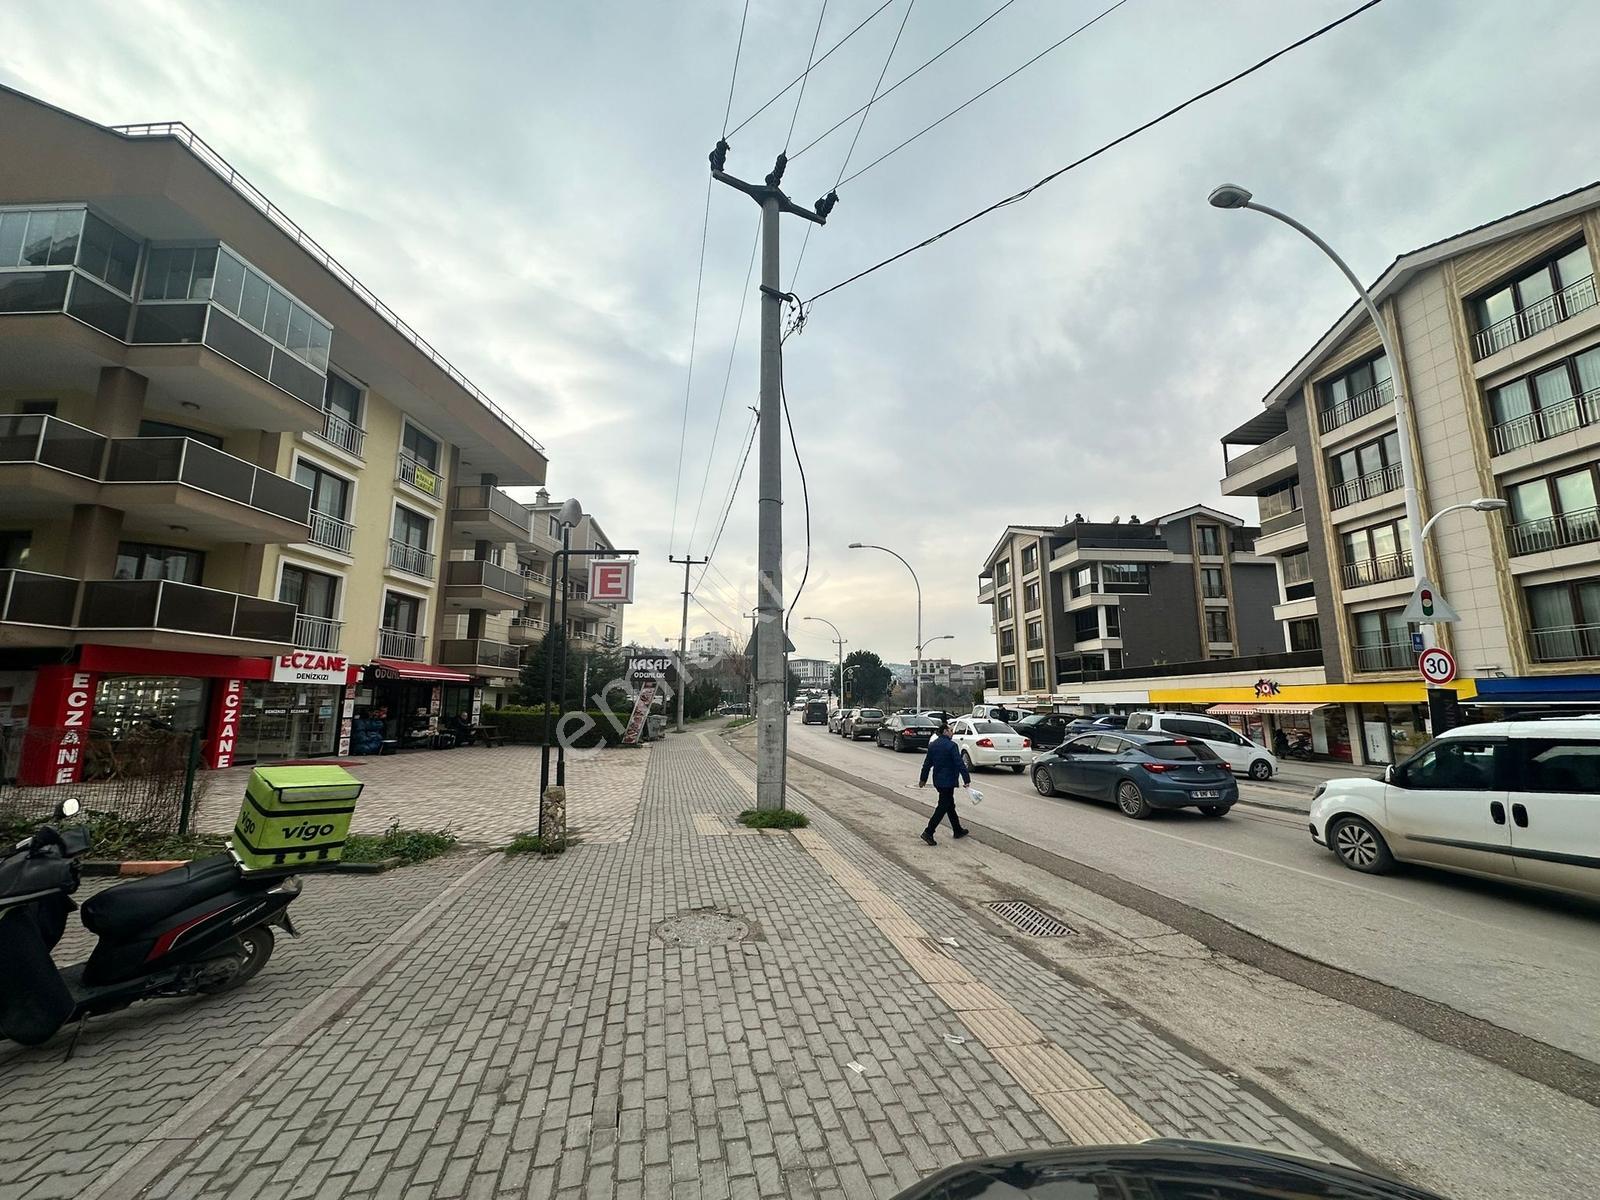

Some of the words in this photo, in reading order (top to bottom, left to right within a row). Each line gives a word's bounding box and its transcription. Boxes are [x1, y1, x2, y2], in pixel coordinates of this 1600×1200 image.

[599, 568, 622, 595] E
[280, 653, 346, 672] ECZANE
[629, 658, 672, 671] KASAP
[1426, 657, 1448, 675] 30
[296, 672, 329, 680] DENİZKIZI
[55, 673, 90, 784] ECZANE
[217, 680, 240, 768] ECZANE
[281, 821, 335, 841] vigo
